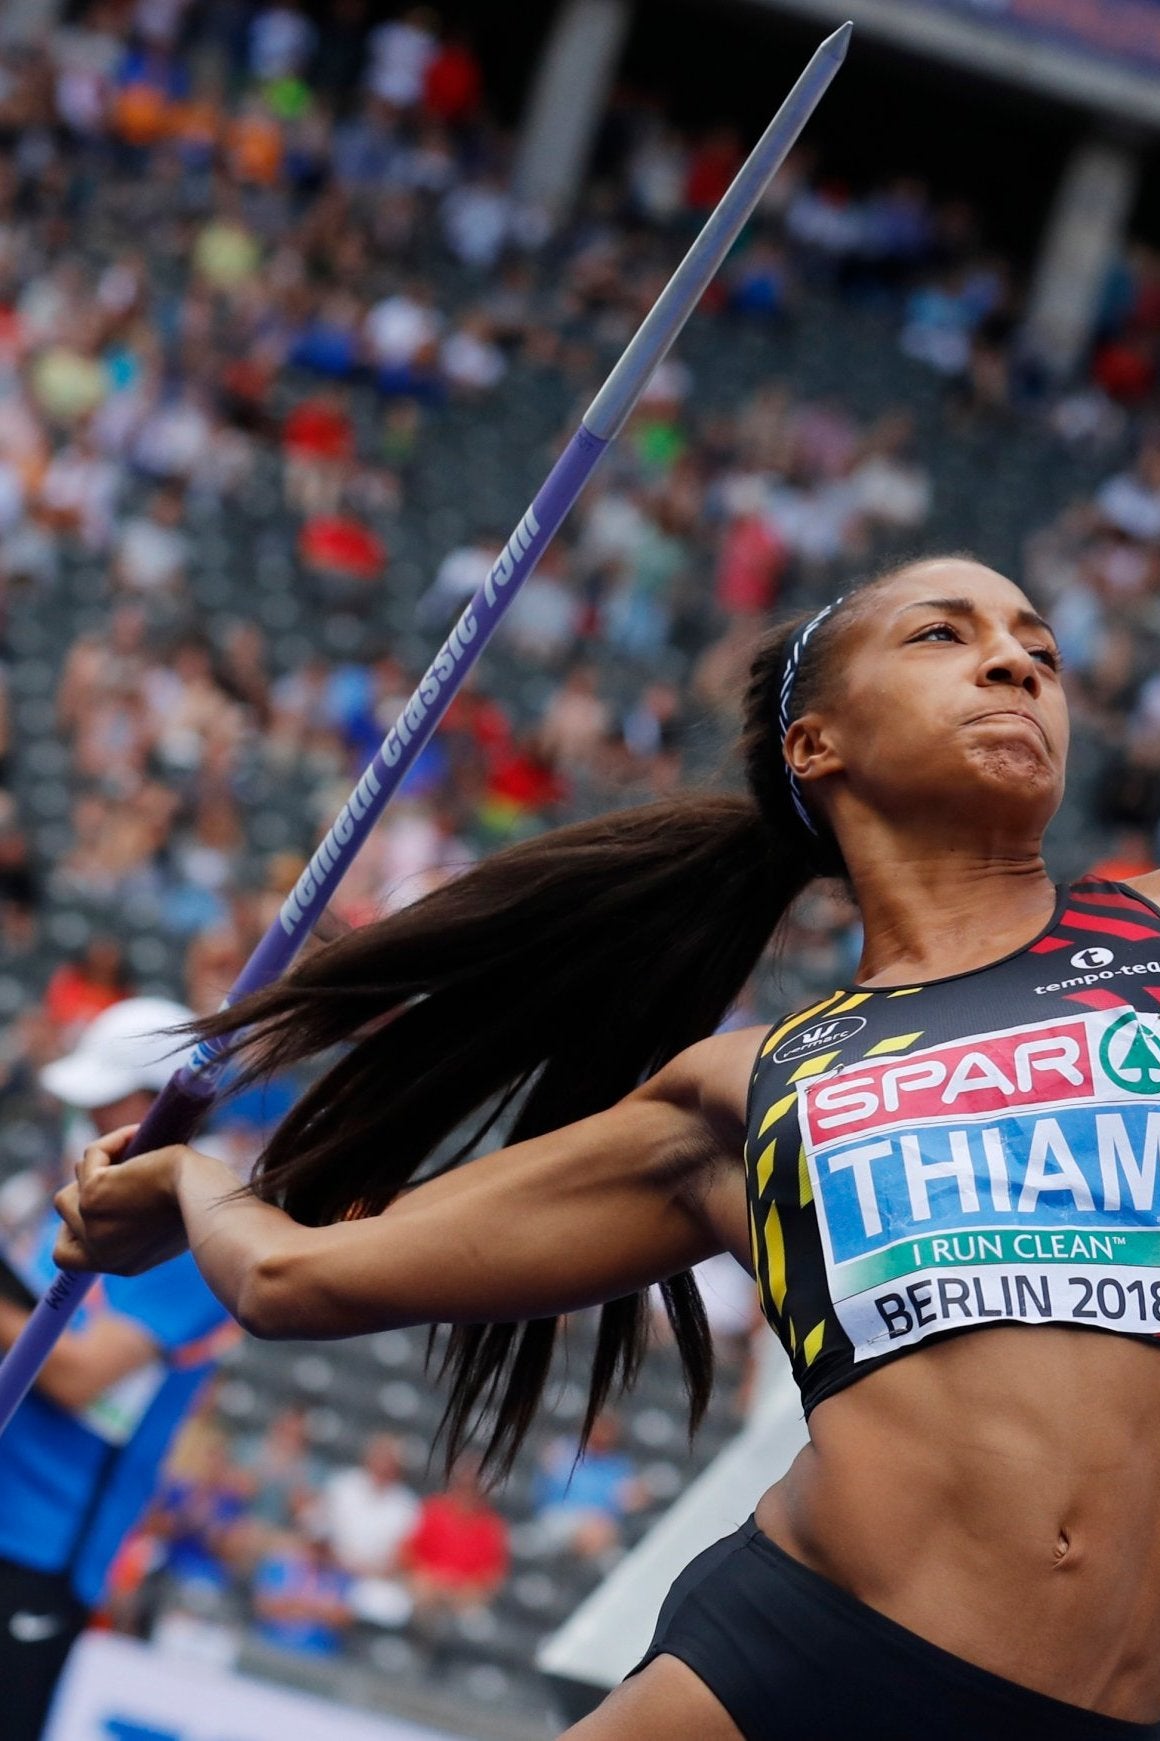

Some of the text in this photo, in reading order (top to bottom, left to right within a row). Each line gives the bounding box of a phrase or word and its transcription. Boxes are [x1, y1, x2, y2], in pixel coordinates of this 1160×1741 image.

[381, 603, 478, 768] Classic
[817, 1036, 1085, 1129] SPAR
[913, 1243, 921, 1266] I
[932, 1235, 1004, 1262] RUN
[875, 1275, 1053, 1340] BERLIN
